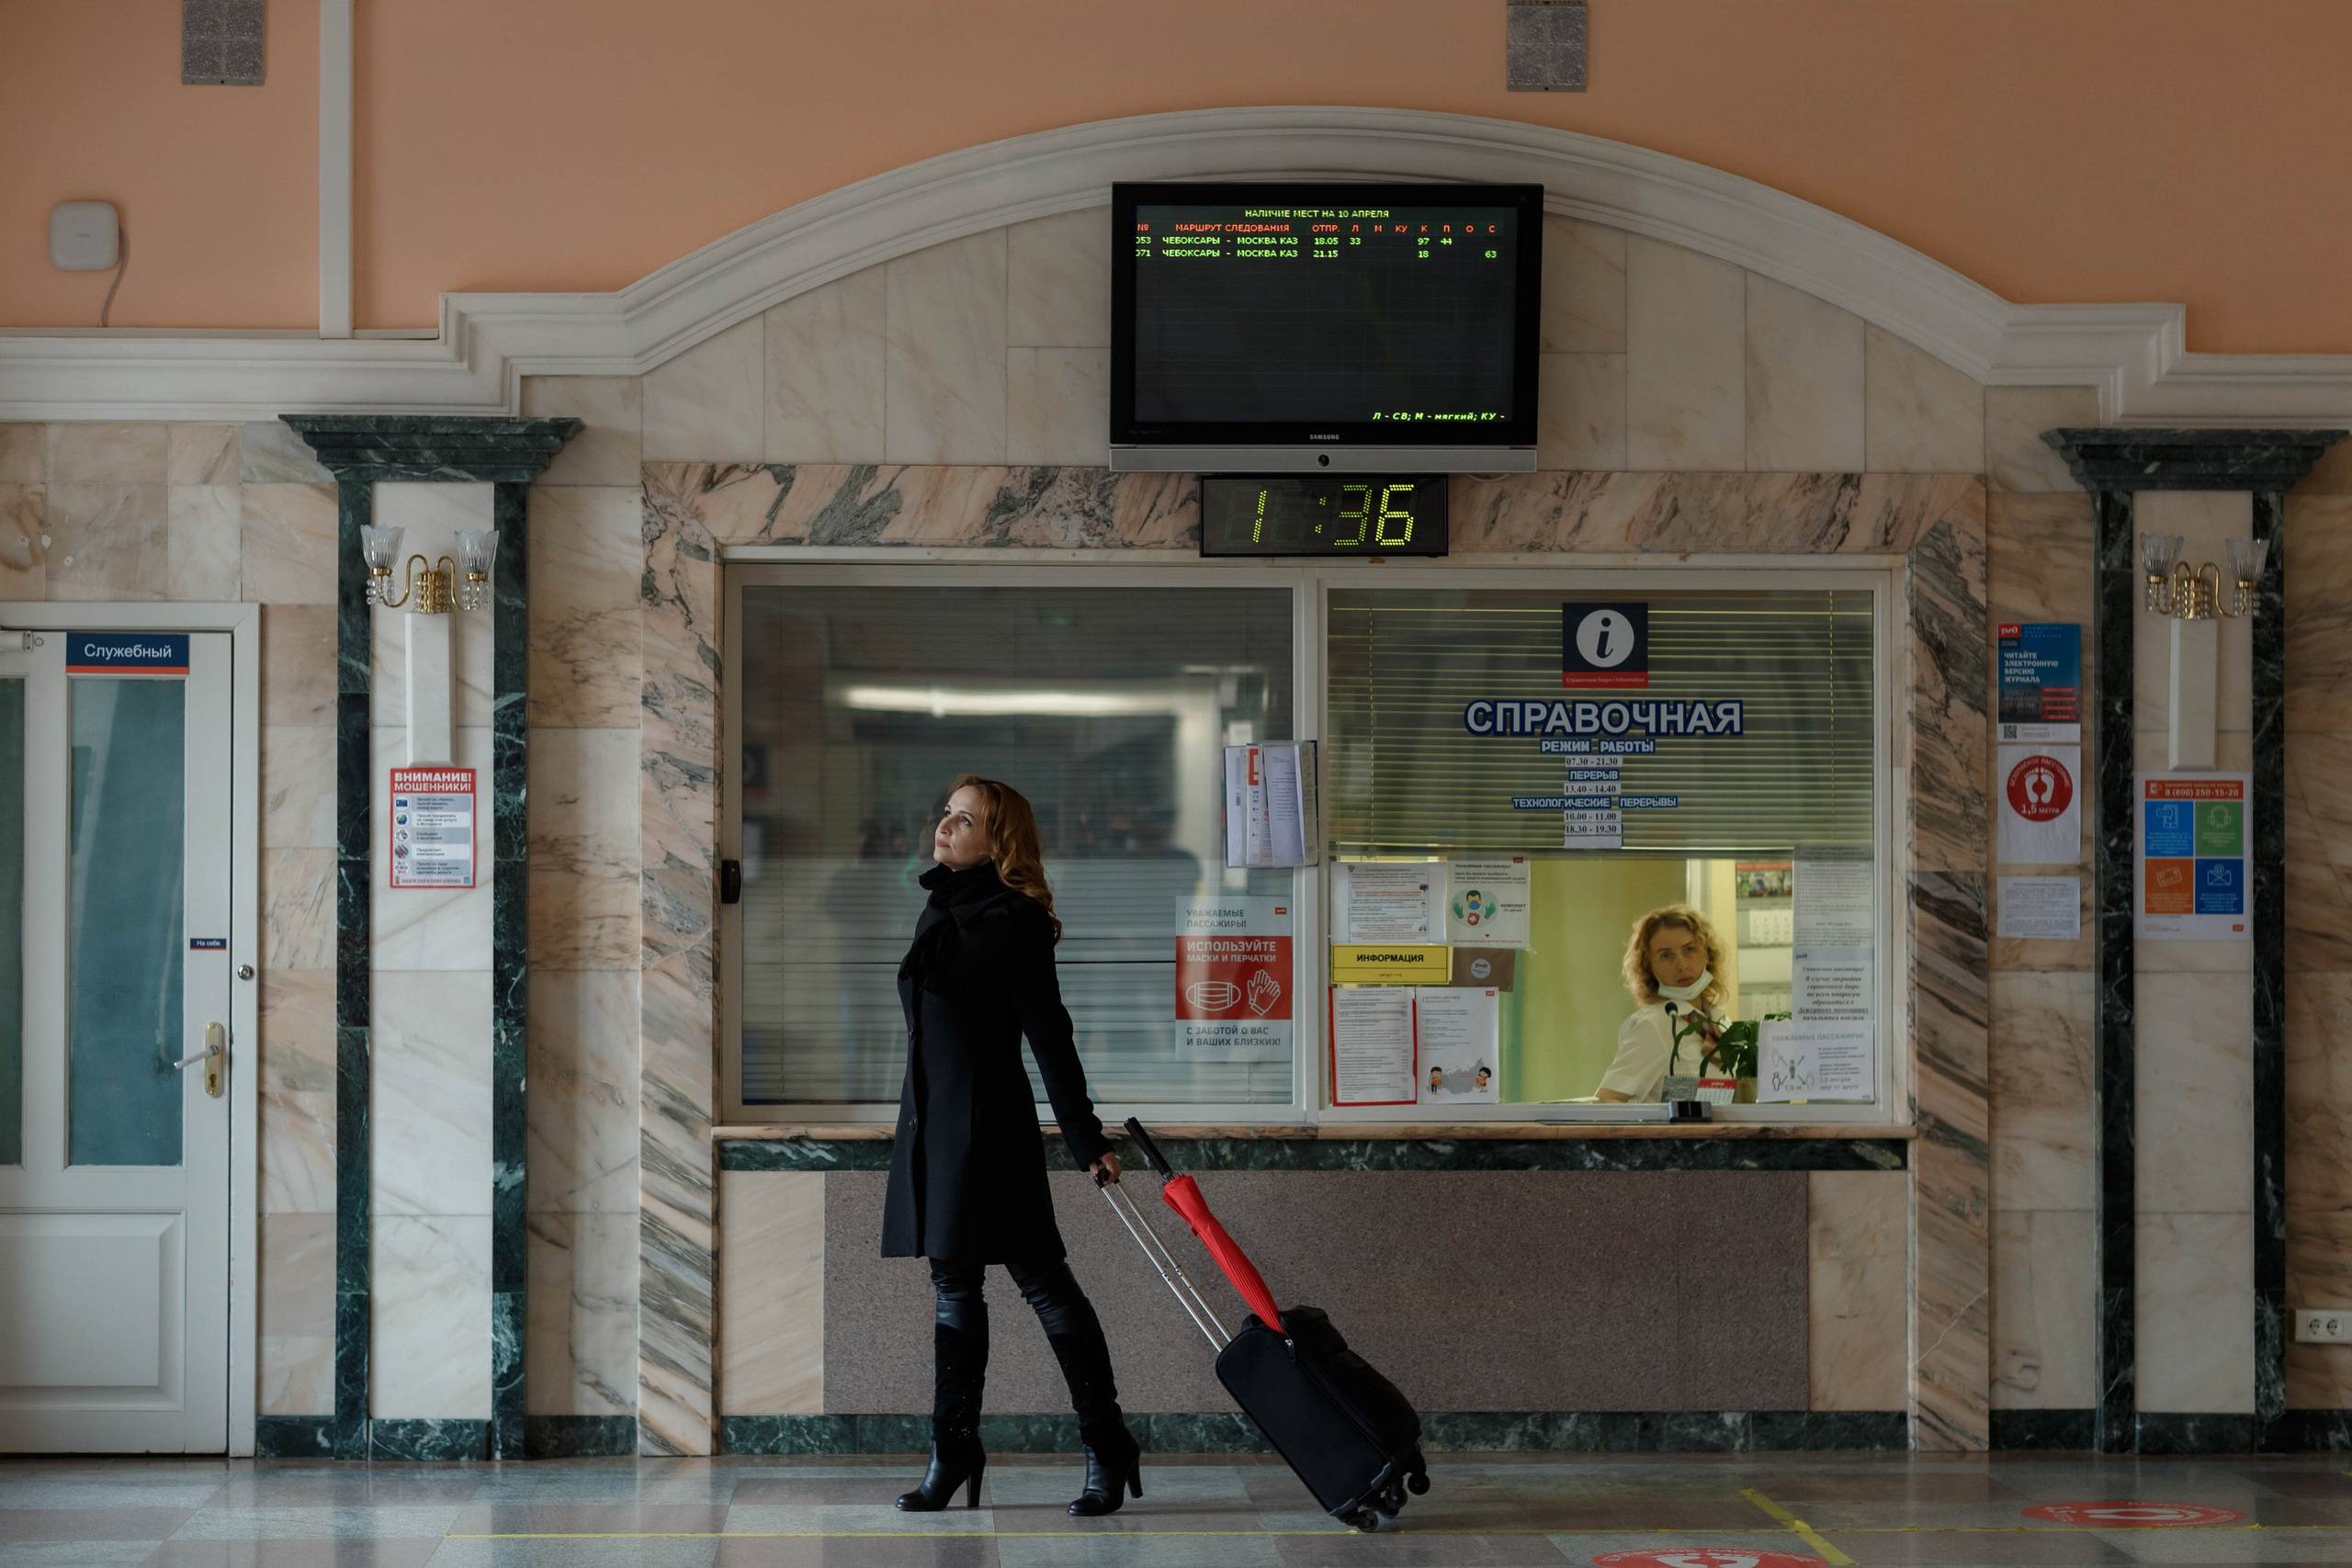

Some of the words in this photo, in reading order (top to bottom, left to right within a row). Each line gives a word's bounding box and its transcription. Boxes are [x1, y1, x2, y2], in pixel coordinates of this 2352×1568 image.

[1175, 224, 1222, 232] МАРШРУТ
[1225, 224, 1290, 232] СЛЕДОВАНИЯ
[1435, 412, 1477, 421] мягкий;
[85, 644, 172, 660] Служебный
[2004, 651, 2037, 659] ЧИТАЙТЕ
[1465, 700, 1742, 735] СПРАВОЧНАЯ
[1541, 739, 1591, 753] РЕЖИМ
[1599, 739, 1655, 753] РАБОТЫ
[1566, 757, 1588, 766] 07.30
[1596, 757, 1618, 766] 21.30
[395, 773, 472, 782] ВНИМАНИЕ!
[1569, 770, 1619, 780] ПЕРЕРЫВ
[394, 783, 471, 791] МОШЕННИКИ!
[1565, 785, 1588, 794] 13.40
[1595, 785, 1616, 794] 14.40
[1513, 798, 1611, 808] ТЕХНОЛОГИЧЕСКИЕ
[1620, 797, 1677, 807] ПЕРЕРЫВЫ
[2021, 803, 2037, 815] 1,5
[1565, 812, 1588, 821] 10.00
[1595, 812, 1617, 821] 11.00
[1565, 825, 1588, 834] 18.30
[1595, 825, 1617, 834] 19.30
[1187, 939, 1276, 952] ИСПОЛЬЗУЙТЕ
[1357, 954, 1424, 964] ИНФОРМАЦИЯ
[1187, 1027, 1192, 1035] С
[1195, 1025, 1238, 1035] ЗАБОТОЙ
[1241, 1027, 1247, 1035] О
[1251, 1027, 1269, 1035] ВАС
